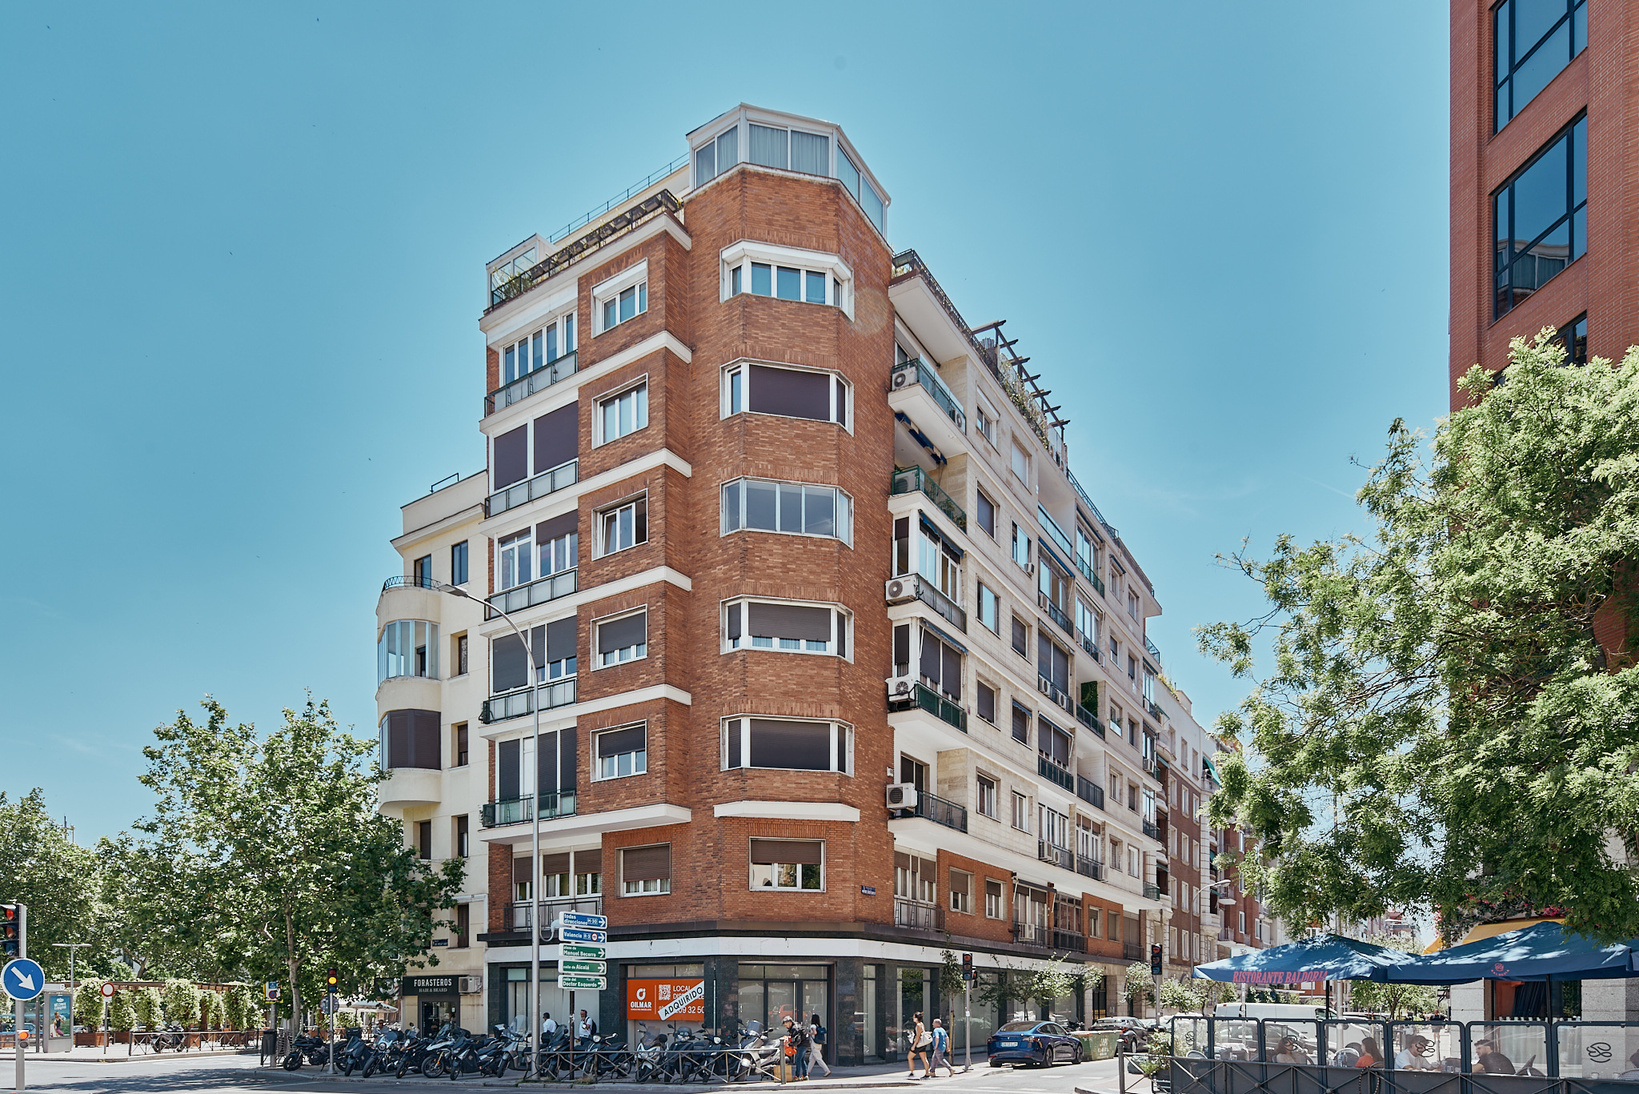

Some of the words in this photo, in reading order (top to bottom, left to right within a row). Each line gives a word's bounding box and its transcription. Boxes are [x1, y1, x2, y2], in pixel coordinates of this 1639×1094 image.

[414, 978, 452, 987] FORASTEROS
[1233, 971, 1284, 984] RISTORANTE
[1285, 970, 1328, 984] BALDORIA
[664, 986, 703, 1016] ADQUIRIDO
